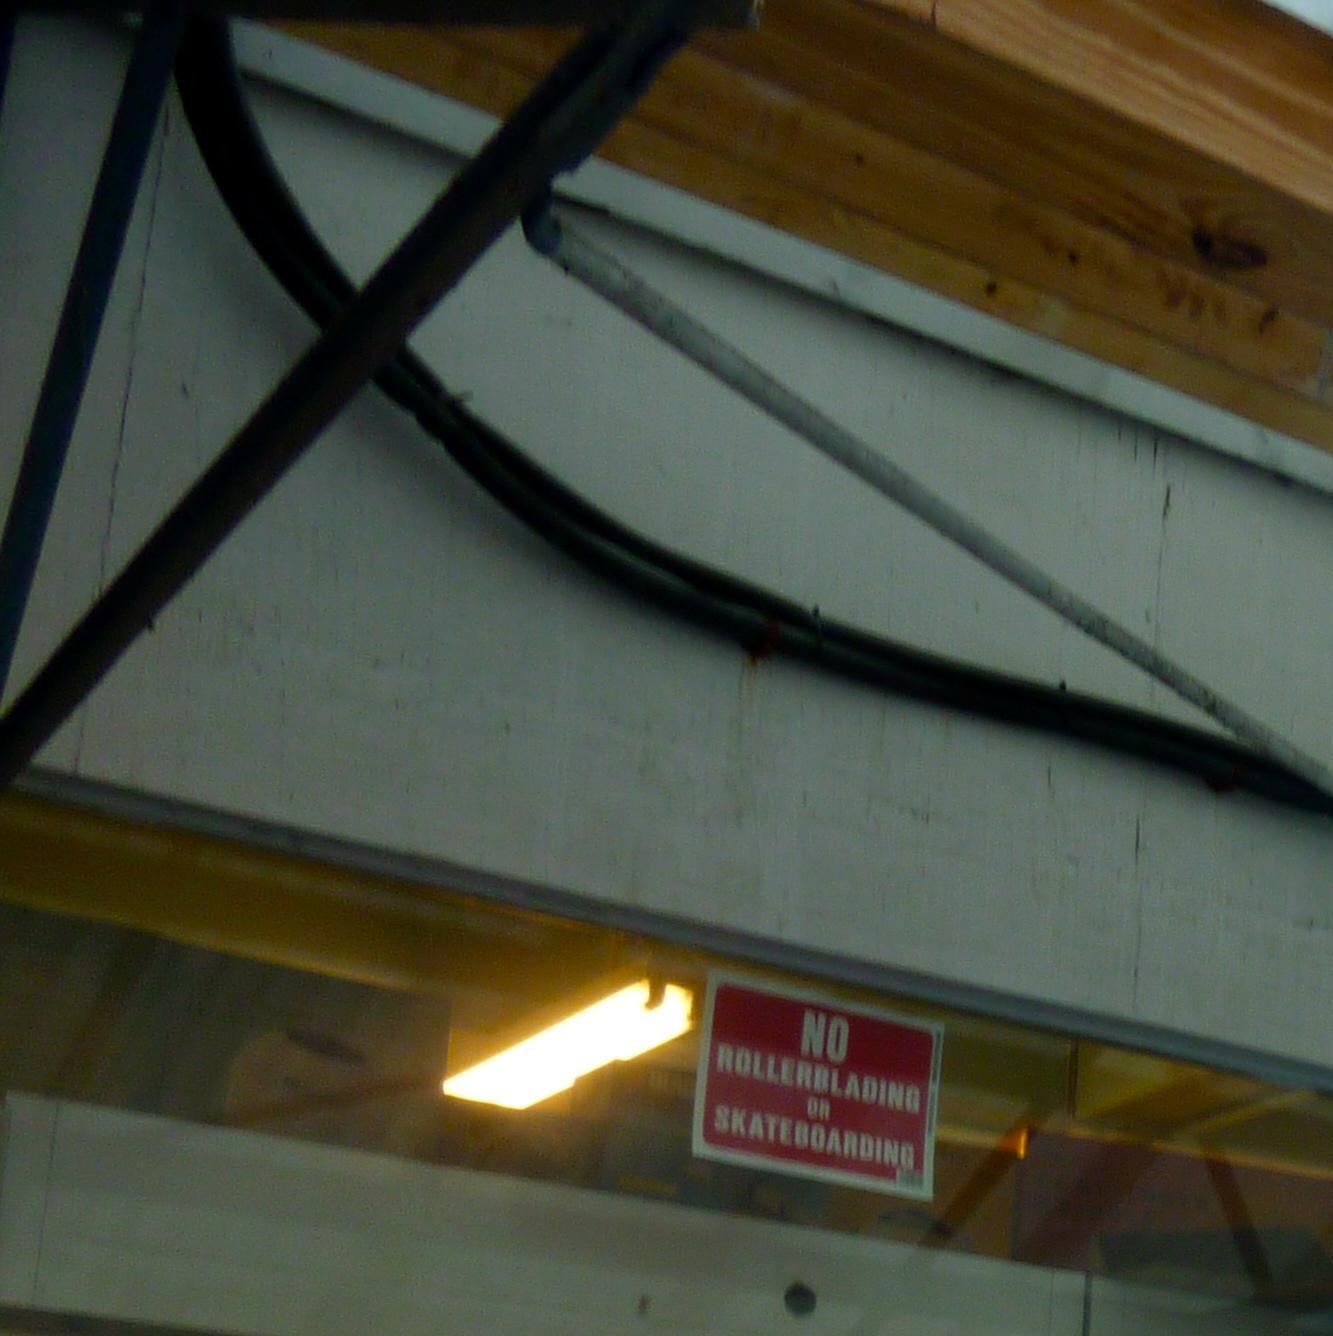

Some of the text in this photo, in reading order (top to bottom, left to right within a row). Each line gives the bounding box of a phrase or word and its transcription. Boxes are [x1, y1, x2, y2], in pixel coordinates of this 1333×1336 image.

[801, 1009, 849, 1063] NO
[716, 1043, 921, 1115] ROLLERBLADING
[806, 1096, 831, 1122] OR
[713, 1104, 915, 1171] SKATEBOARDING
